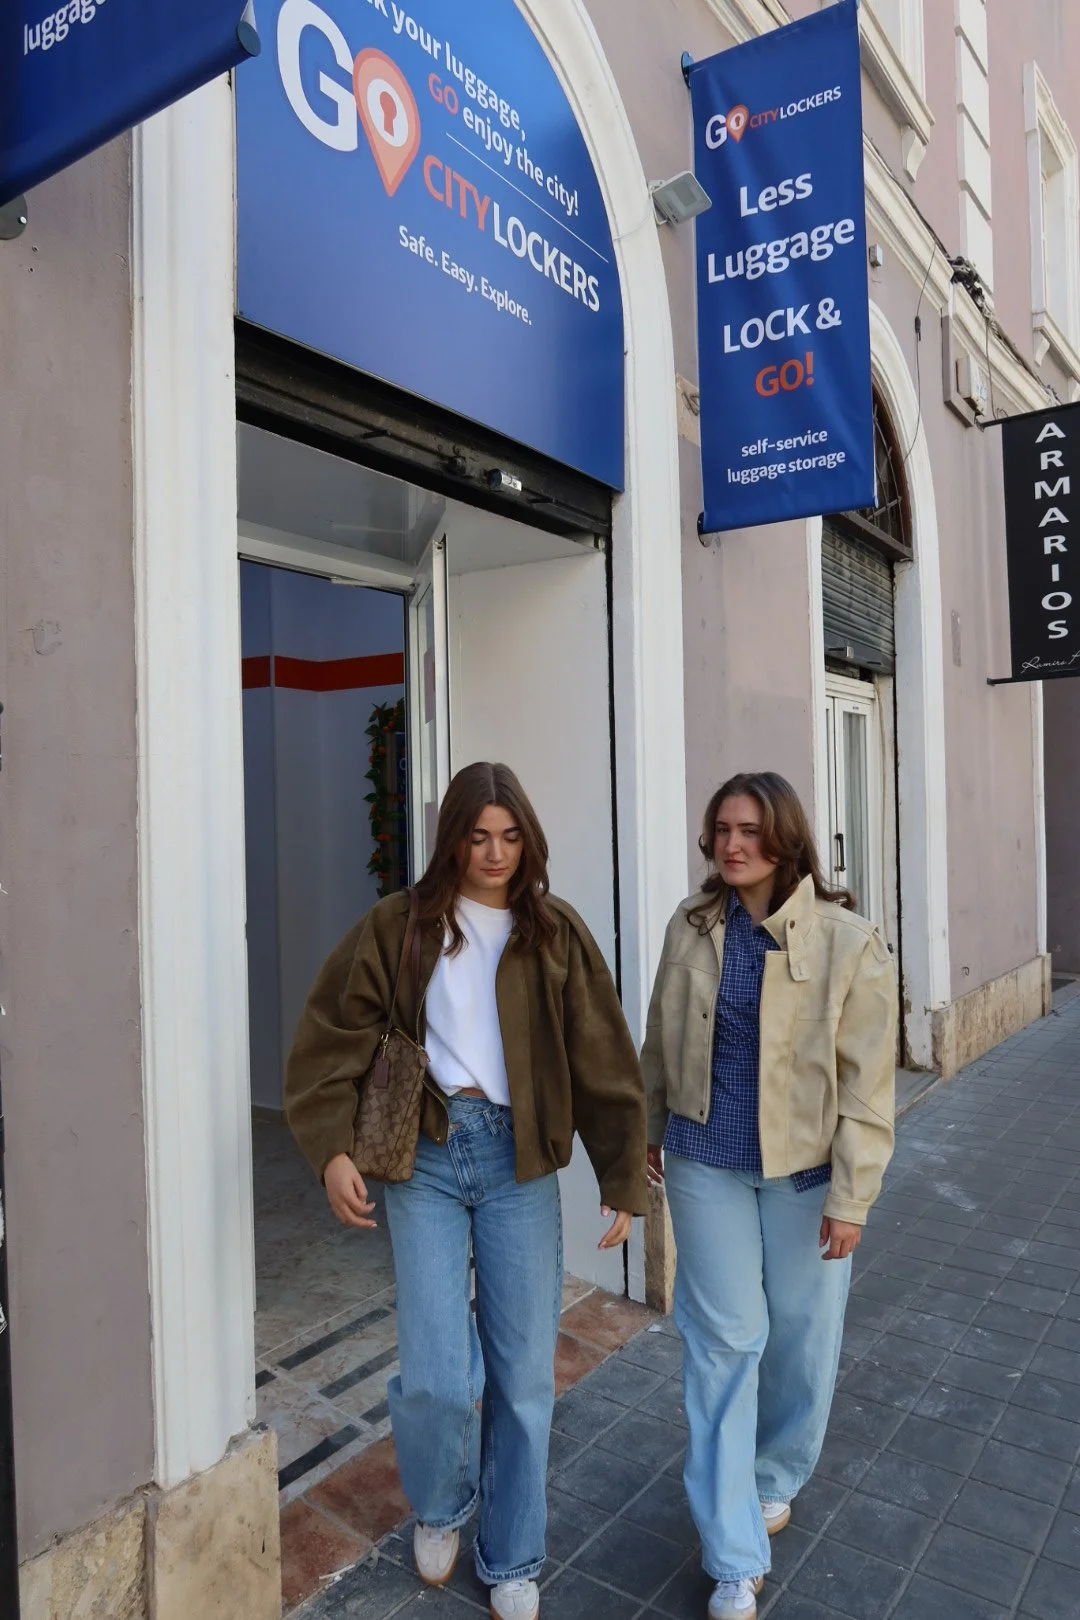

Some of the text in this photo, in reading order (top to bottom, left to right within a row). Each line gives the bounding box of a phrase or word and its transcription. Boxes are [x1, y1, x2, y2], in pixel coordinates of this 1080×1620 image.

[23, 0, 106, 56] luggag
[391, 1, 526, 142] your luggage,
[428, 72, 579, 217] GO enjoy the city!
[739, 172, 813, 218] Less
[398, 224, 533, 326] Safe. Easy. Explore.
[707, 218, 855, 284] Luggage
[723, 297, 842, 354] LOCK &
[755, 351, 815, 398] GO!
[727, 451, 846, 485] luggage storage
[741, 429, 828, 458] self-service
[1034, 421, 1073, 640] ARMARIOS
